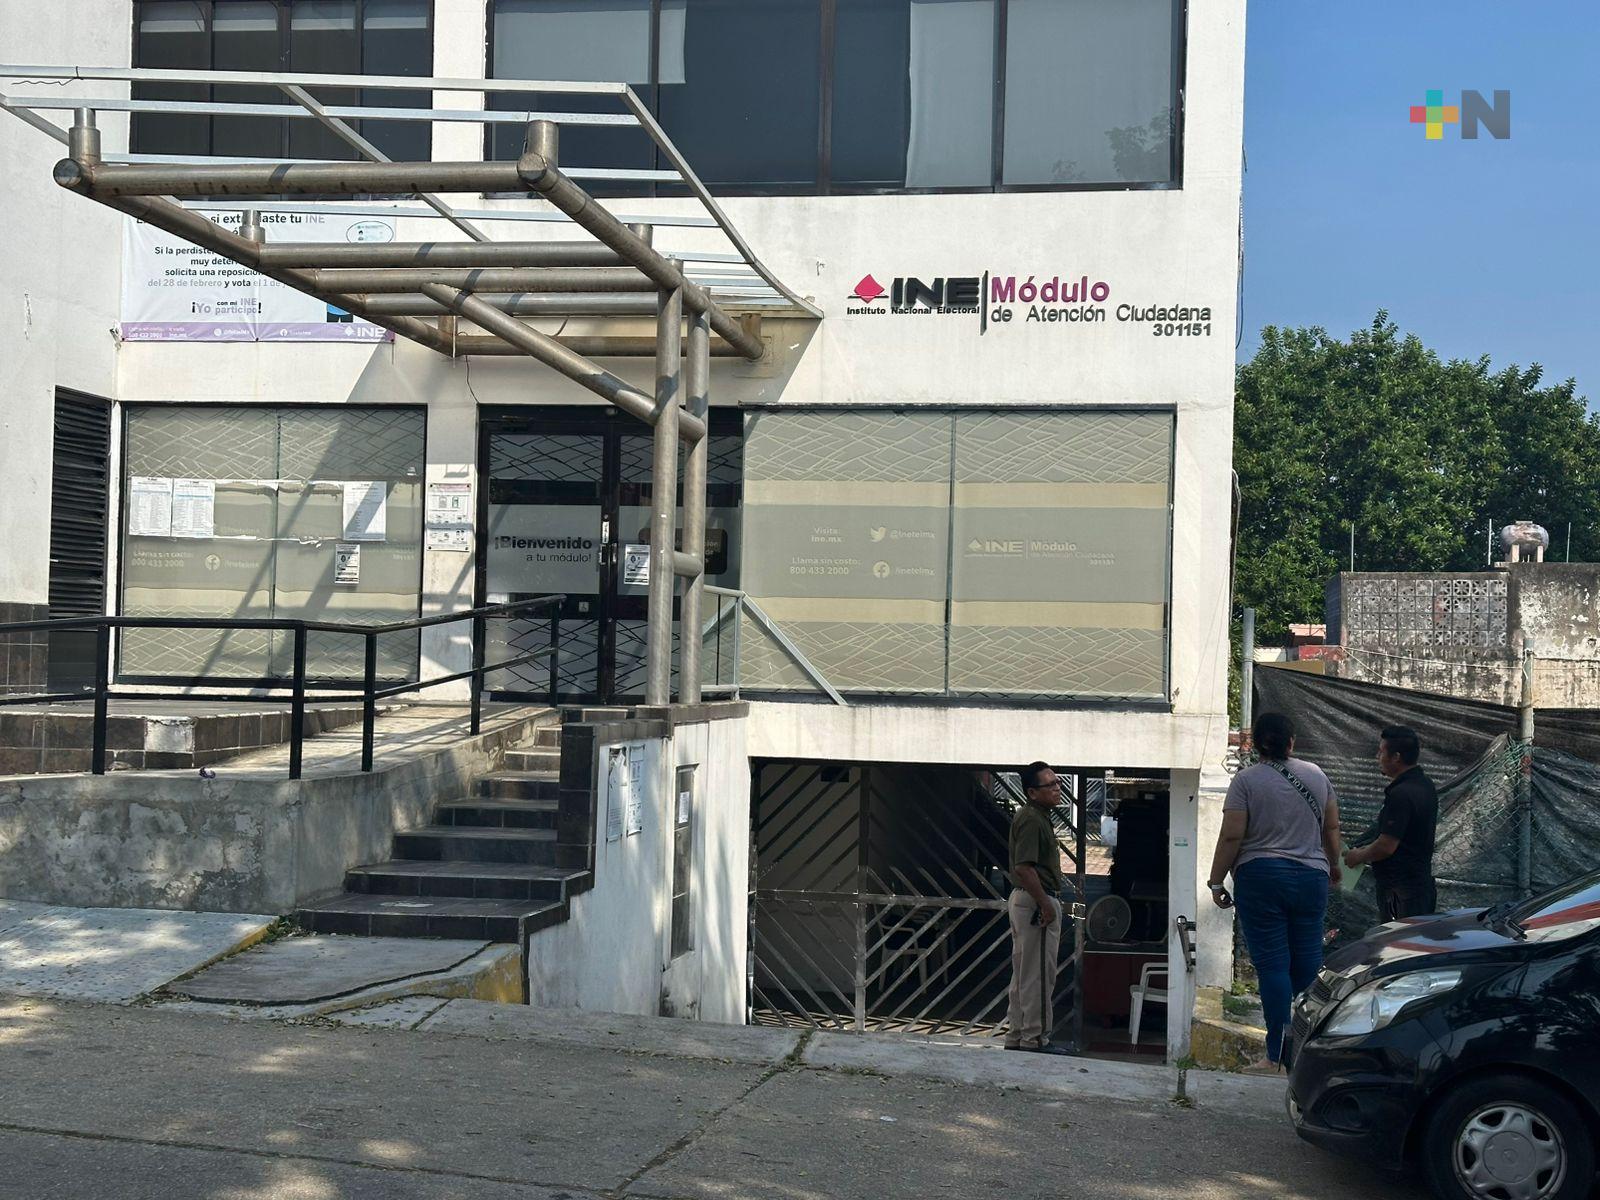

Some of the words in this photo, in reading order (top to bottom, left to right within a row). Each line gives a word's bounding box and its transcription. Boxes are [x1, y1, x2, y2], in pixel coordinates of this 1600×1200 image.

[210, 213, 220, 224] si
[290, 213, 302, 223] tu
[305, 214, 326, 224] INE
[154, 246, 163, 255] Si
[165, 246, 174, 255] la
[190, 258, 210, 267] muy
[165, 268, 197, 276] solicita
[147, 279, 160, 287] del
[163, 279, 174, 287] 28
[177, 279, 188, 287] de
[190, 279, 222, 287] febrero
[224, 280, 230, 288] y
[263, 279, 268, 287] 1
[889, 277, 980, 307] INE
[991, 275, 1110, 303] Módulo
[240, 298, 257, 306] INE
[846, 306, 886, 315] Instituto
[891, 306, 932, 315] Nacional
[937, 306, 980, 315] Electoral
[990, 305, 1012, 322] de
[1026, 304, 1105, 322] Atención
[1116, 304, 1211, 322] Ciudadana
[1153, 323, 1211, 337] 301151
[985, 541, 1024, 553] INE
[526, 554, 533, 562] a
[536, 553, 546, 562] tu
[790, 566, 807, 575] 800
[808, 566, 825, 575] 433
[827, 566, 849, 575] 2000
